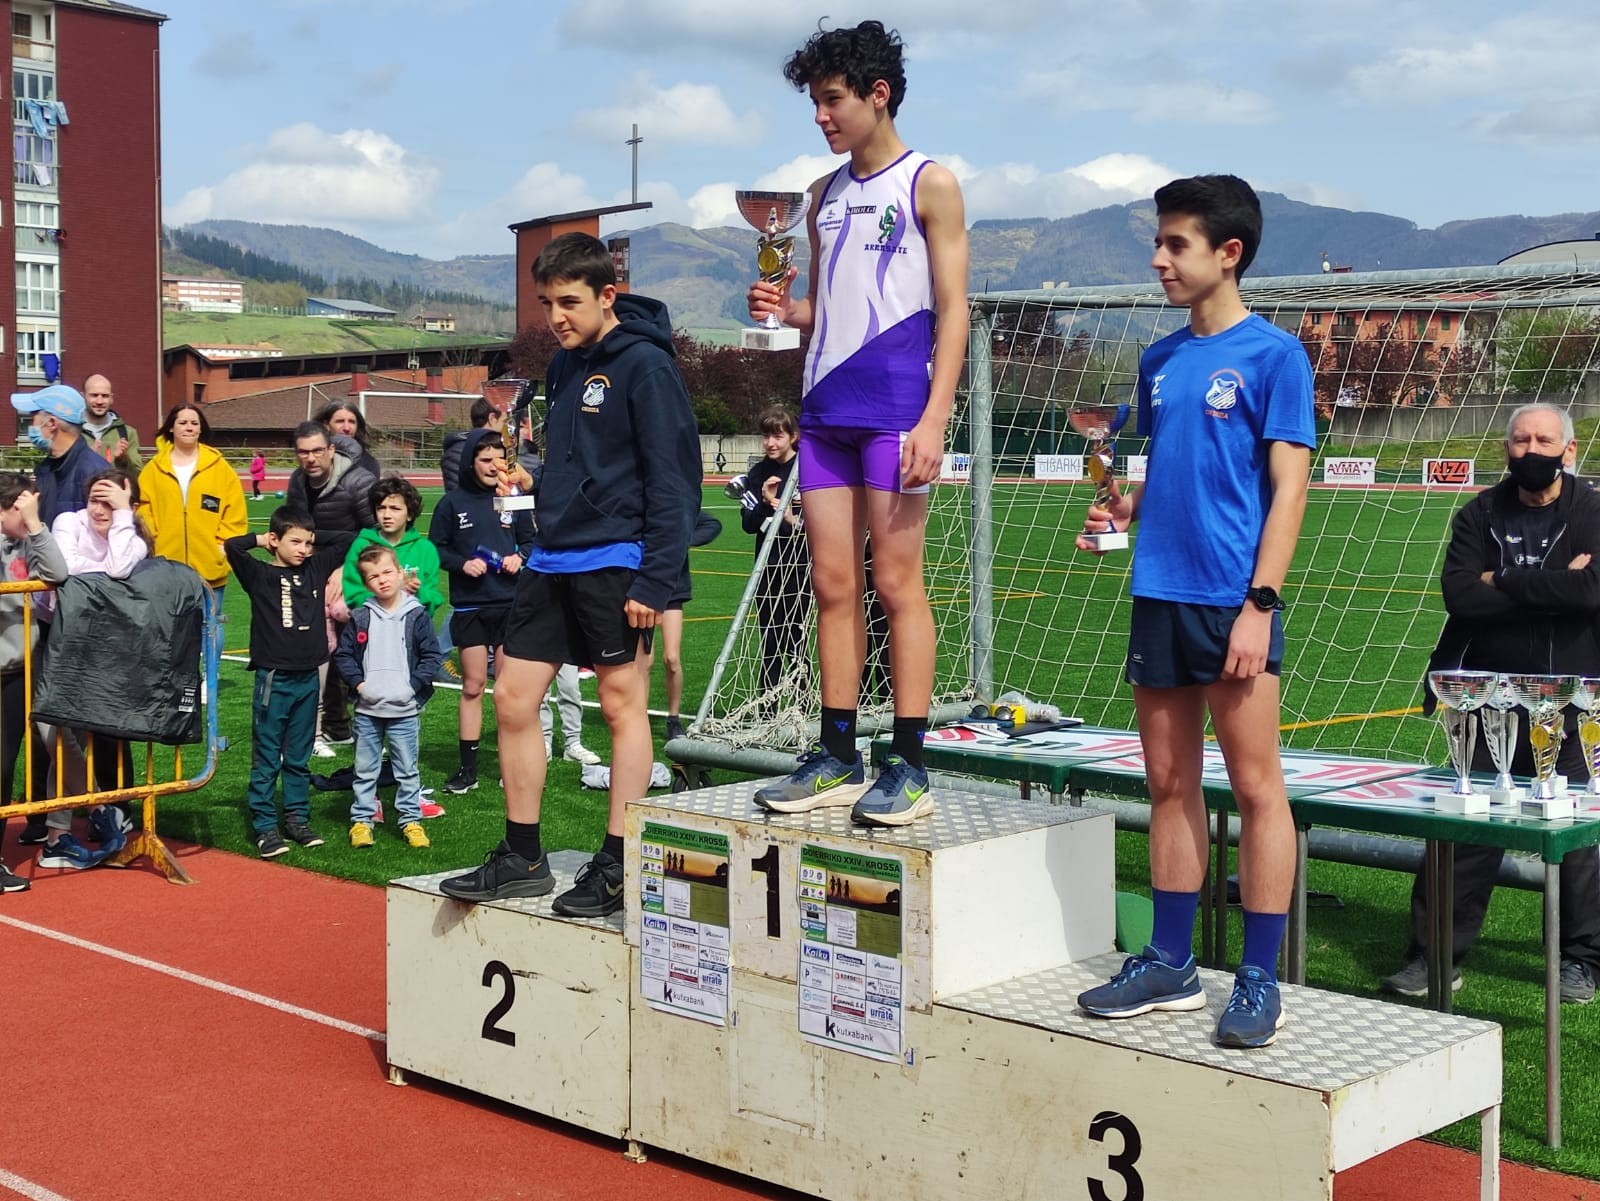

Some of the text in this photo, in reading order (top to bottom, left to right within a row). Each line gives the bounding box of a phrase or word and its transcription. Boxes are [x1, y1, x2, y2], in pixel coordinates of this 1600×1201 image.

[1327, 463, 1360, 474] AYMA
[699, 836, 728, 847] KROSSA
[866, 861, 900, 873] KROSSA
[752, 845, 780, 938] 1
[804, 945, 829, 961] Kaiku
[481, 960, 515, 1047] 2
[673, 991, 705, 1006] kutxabank
[836, 1025, 874, 1042] kutxabank
[1087, 1111, 1145, 1201] 3
